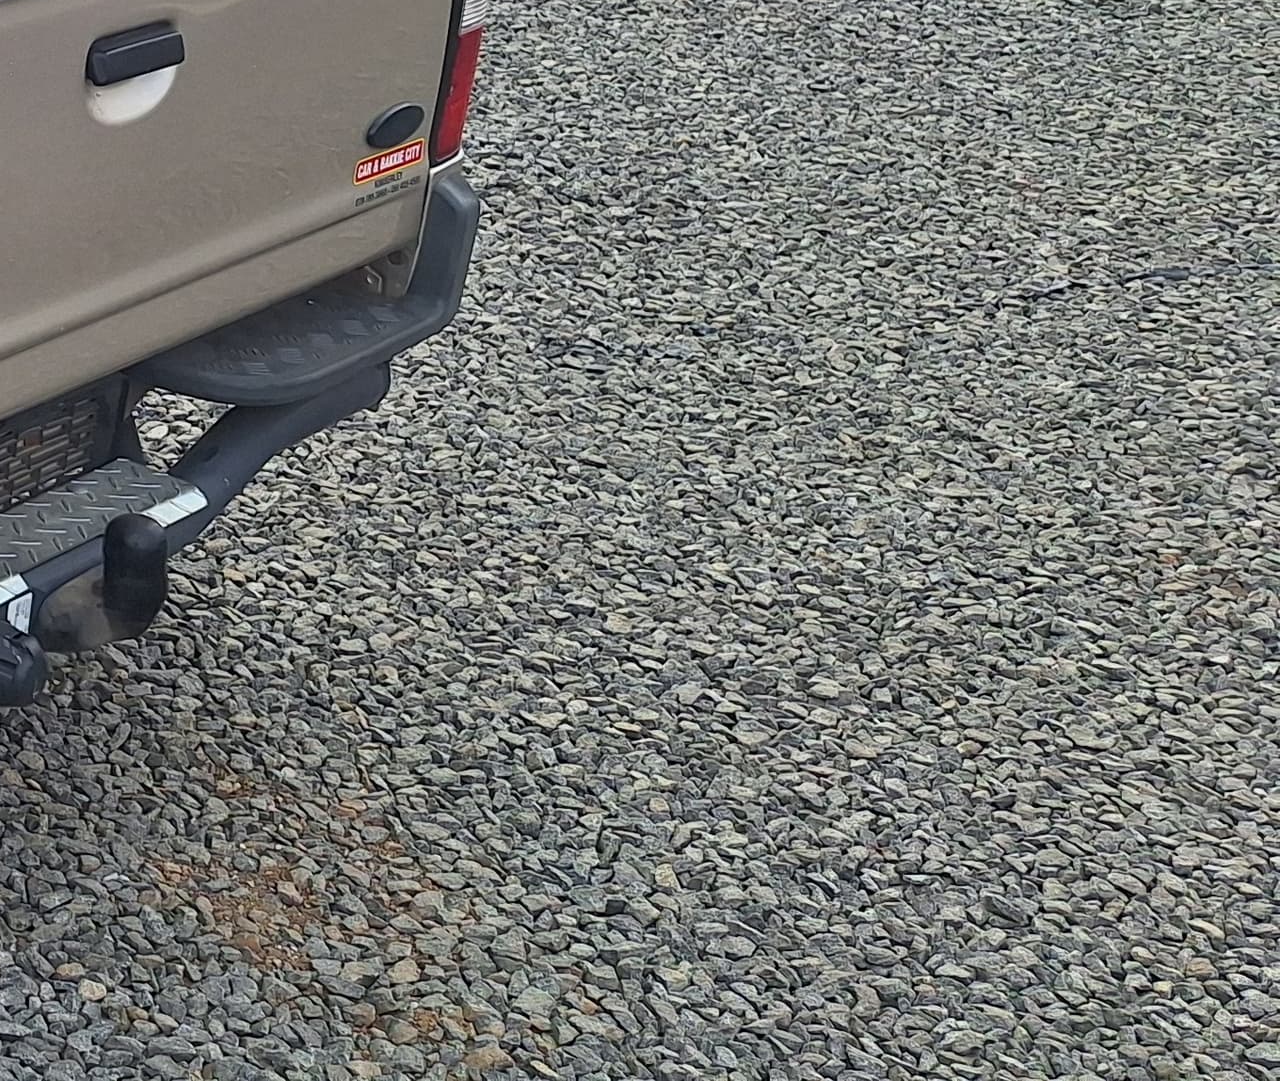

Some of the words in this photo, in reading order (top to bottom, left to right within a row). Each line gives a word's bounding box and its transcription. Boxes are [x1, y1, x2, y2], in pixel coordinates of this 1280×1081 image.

[357, 162, 373, 179] CAR
[380, 149, 406, 170] BAKKIE
[405, 143, 421, 162] CITY
